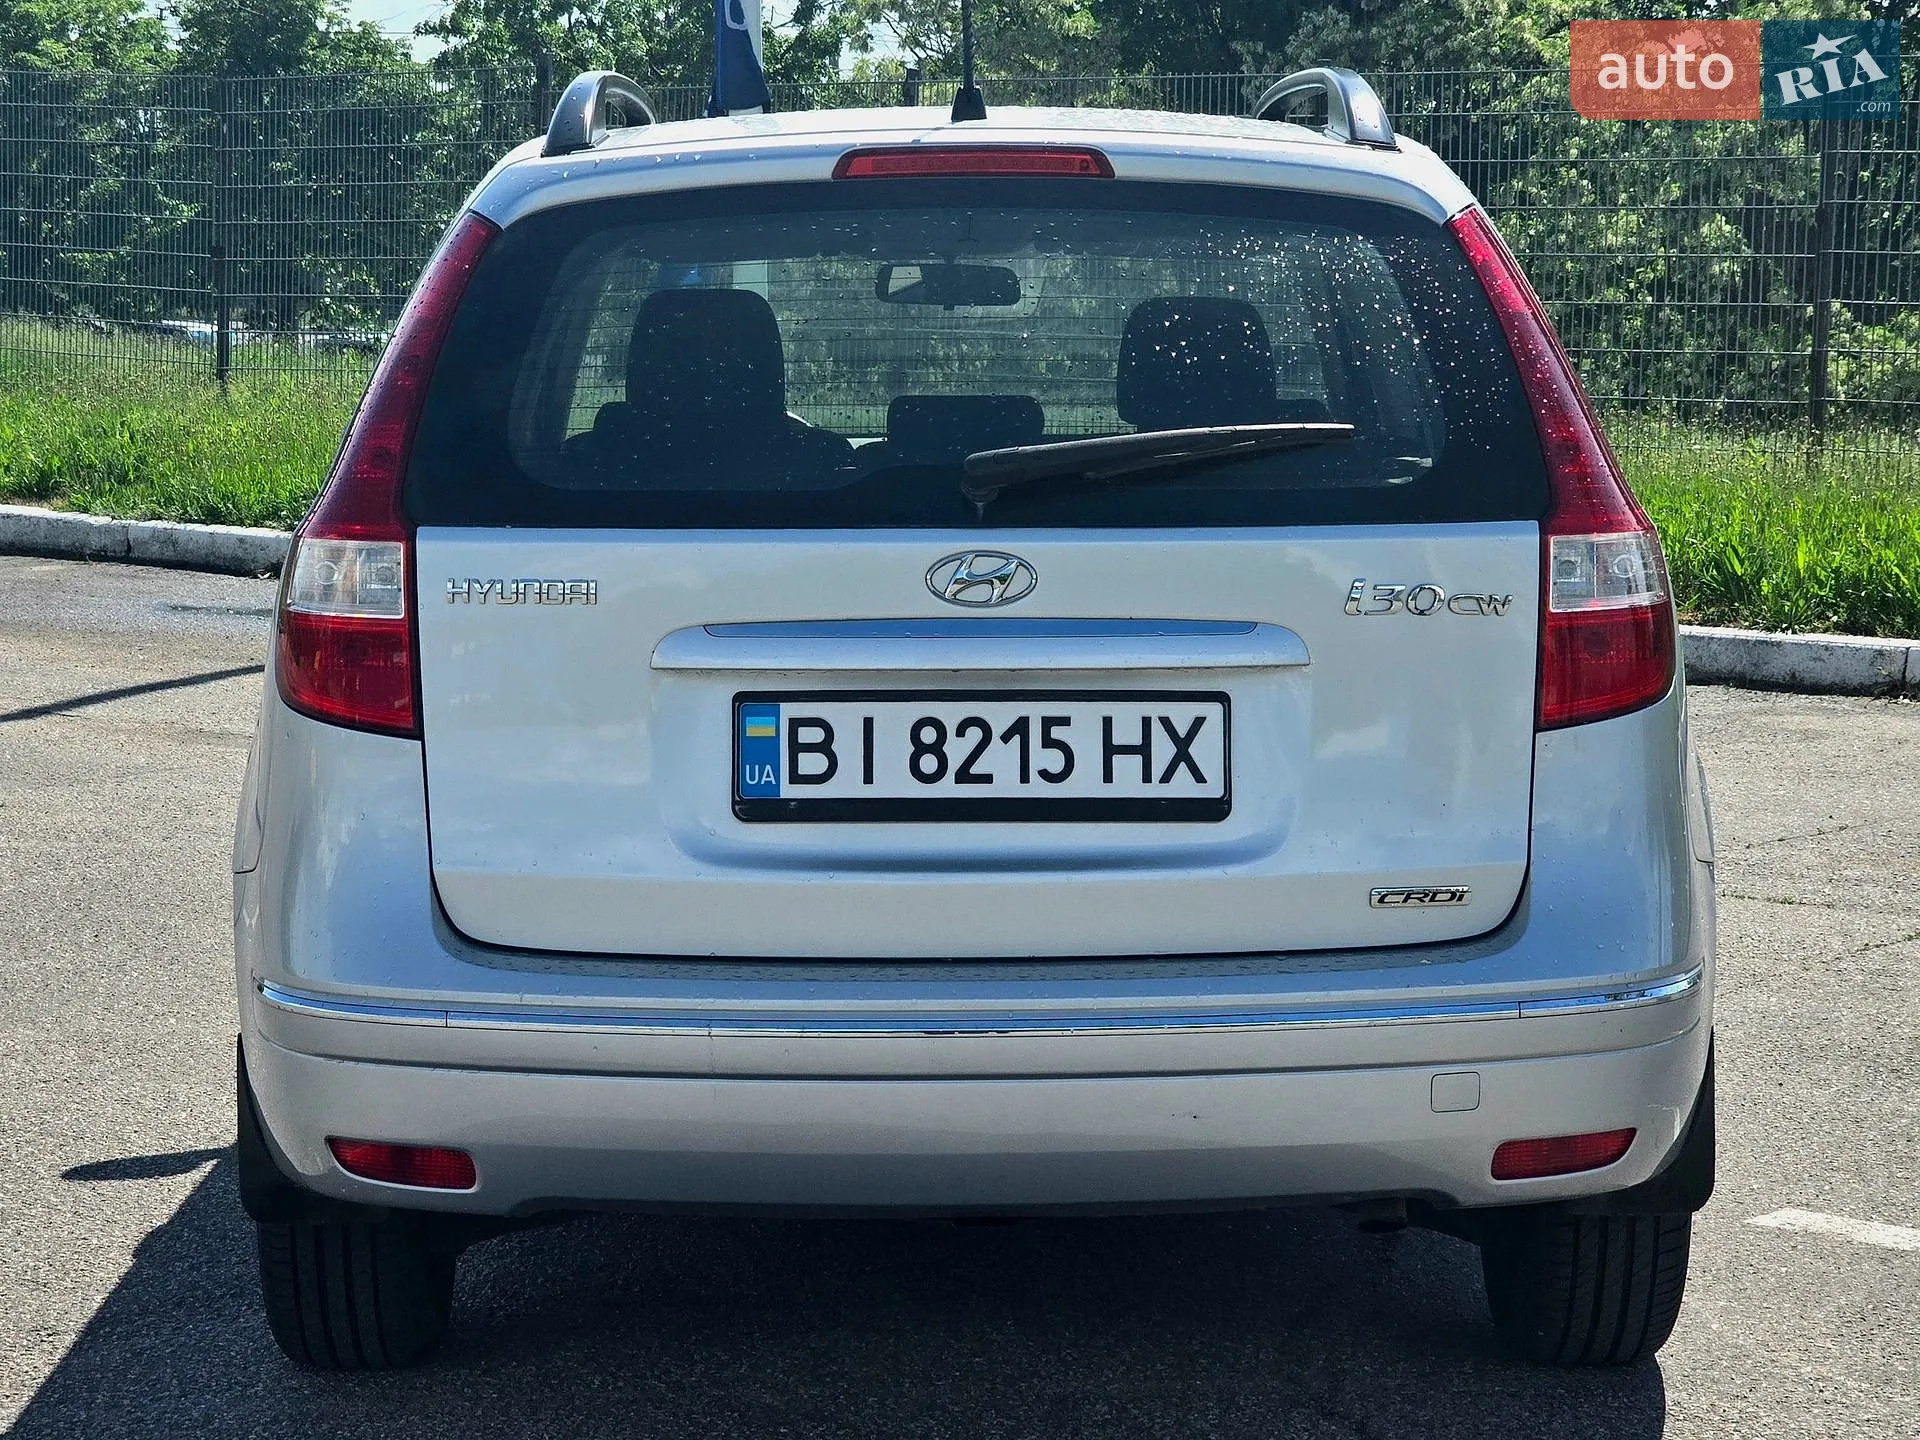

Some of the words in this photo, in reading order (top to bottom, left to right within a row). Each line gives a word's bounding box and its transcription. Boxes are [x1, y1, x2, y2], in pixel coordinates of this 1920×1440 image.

[447, 577, 598, 605] HYUNDAI
[787, 717, 874, 785] BI
[908, 716, 1076, 784] 8215
[1102, 716, 1208, 784] HX
[745, 765, 776, 785] UA
[1377, 891, 1465, 904] CRDi
